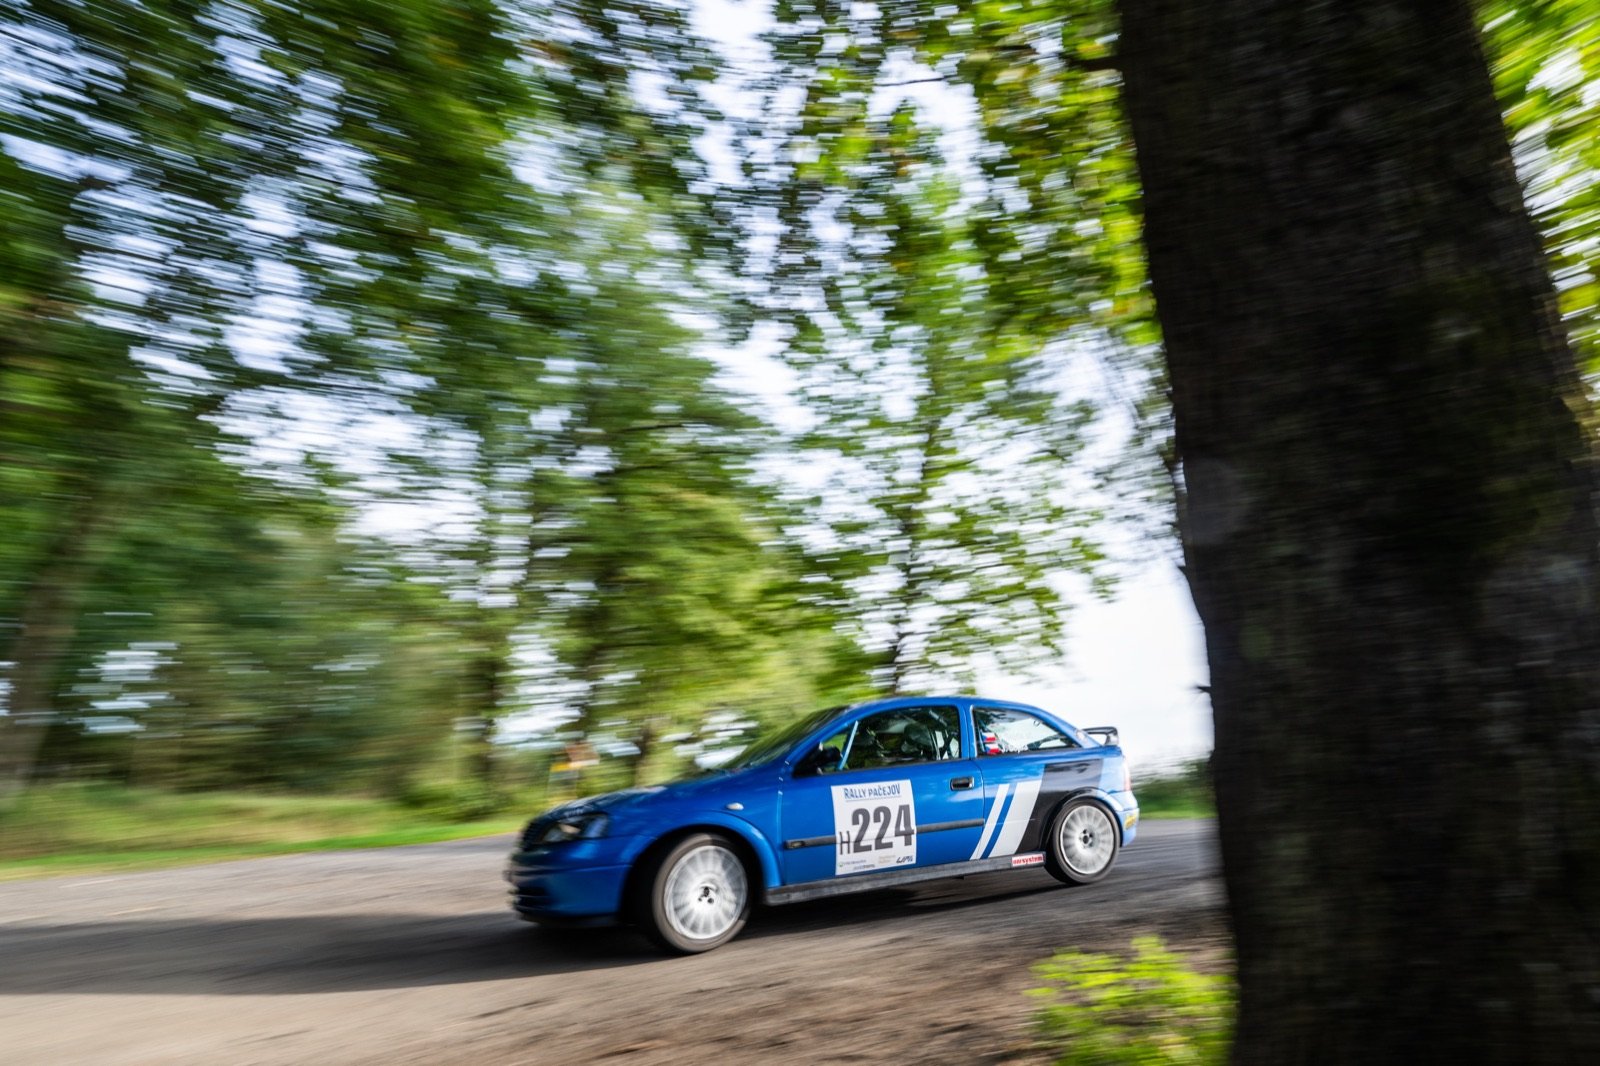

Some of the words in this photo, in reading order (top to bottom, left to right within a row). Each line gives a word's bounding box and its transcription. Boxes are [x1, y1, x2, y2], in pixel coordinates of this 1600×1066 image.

[844, 787, 866, 799] RALLY
[868, 783, 900, 797] PAČEJOV
[852, 804, 914, 853] 224
